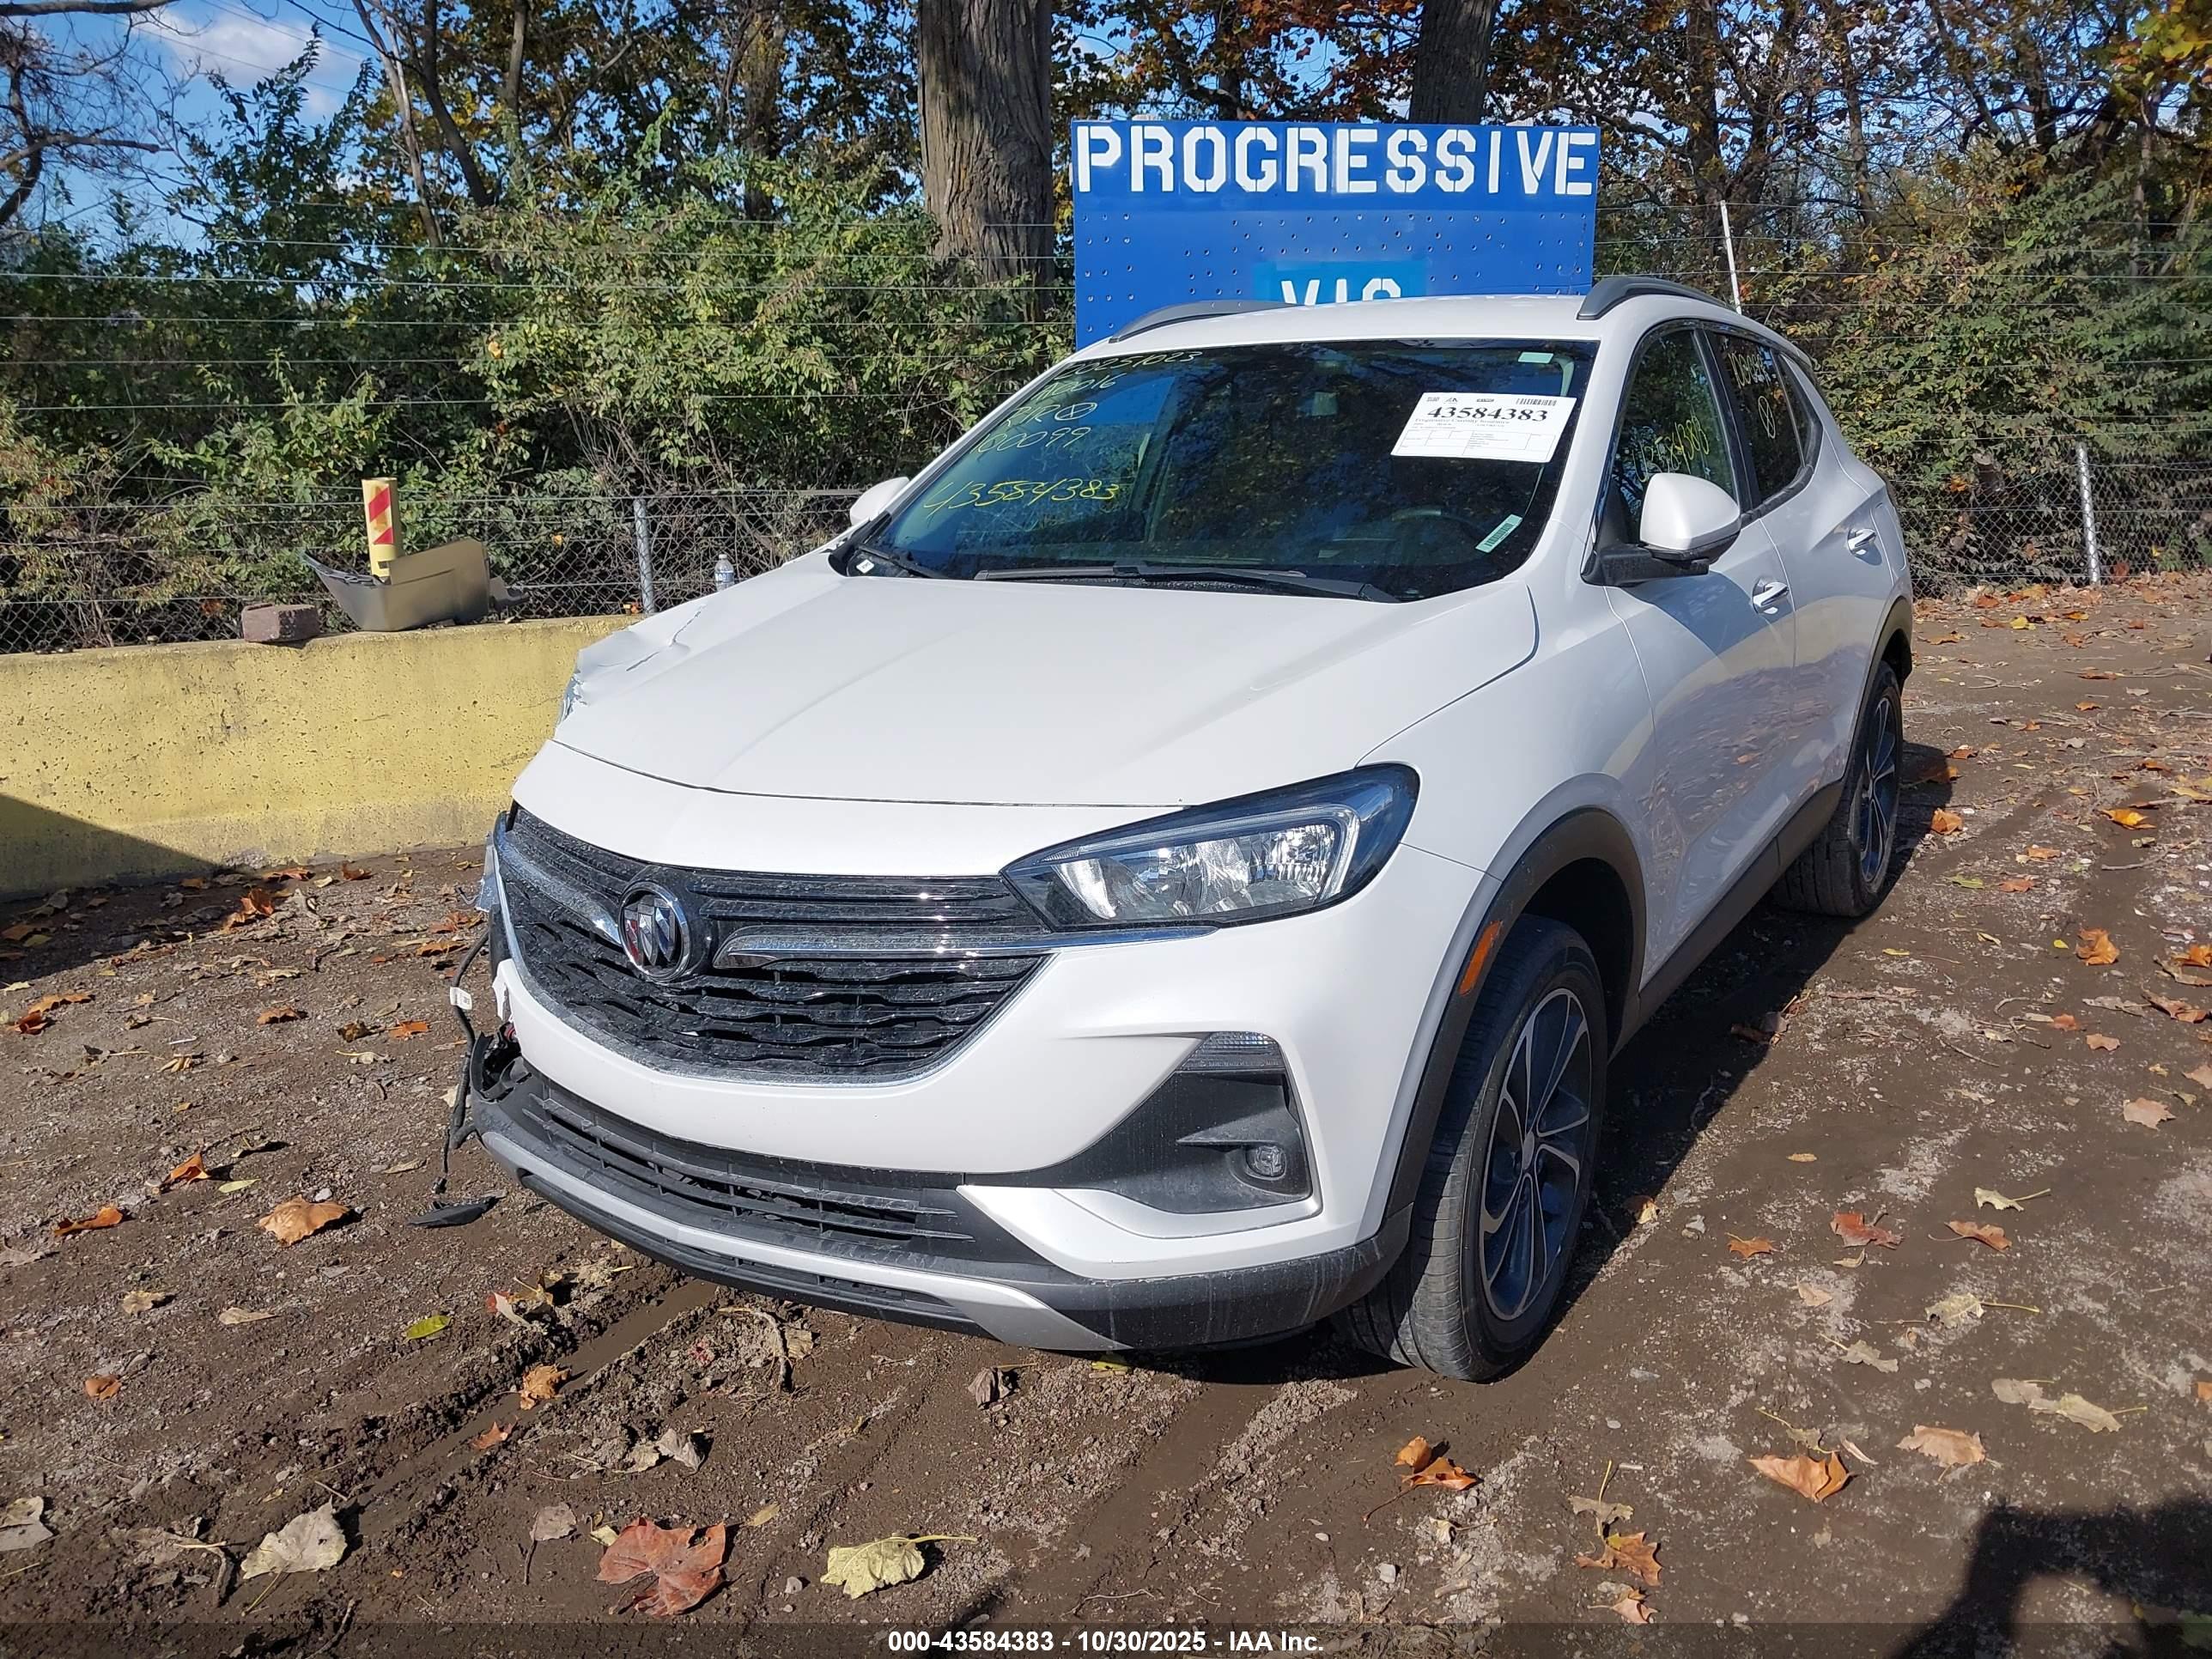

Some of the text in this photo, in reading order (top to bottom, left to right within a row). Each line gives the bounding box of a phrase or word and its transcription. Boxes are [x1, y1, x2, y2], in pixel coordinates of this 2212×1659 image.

[1076, 125, 1596, 195] PROGRESSIVE
[1427, 406, 1548, 422] 43584383
[923, 478, 1119, 519] 43584383
